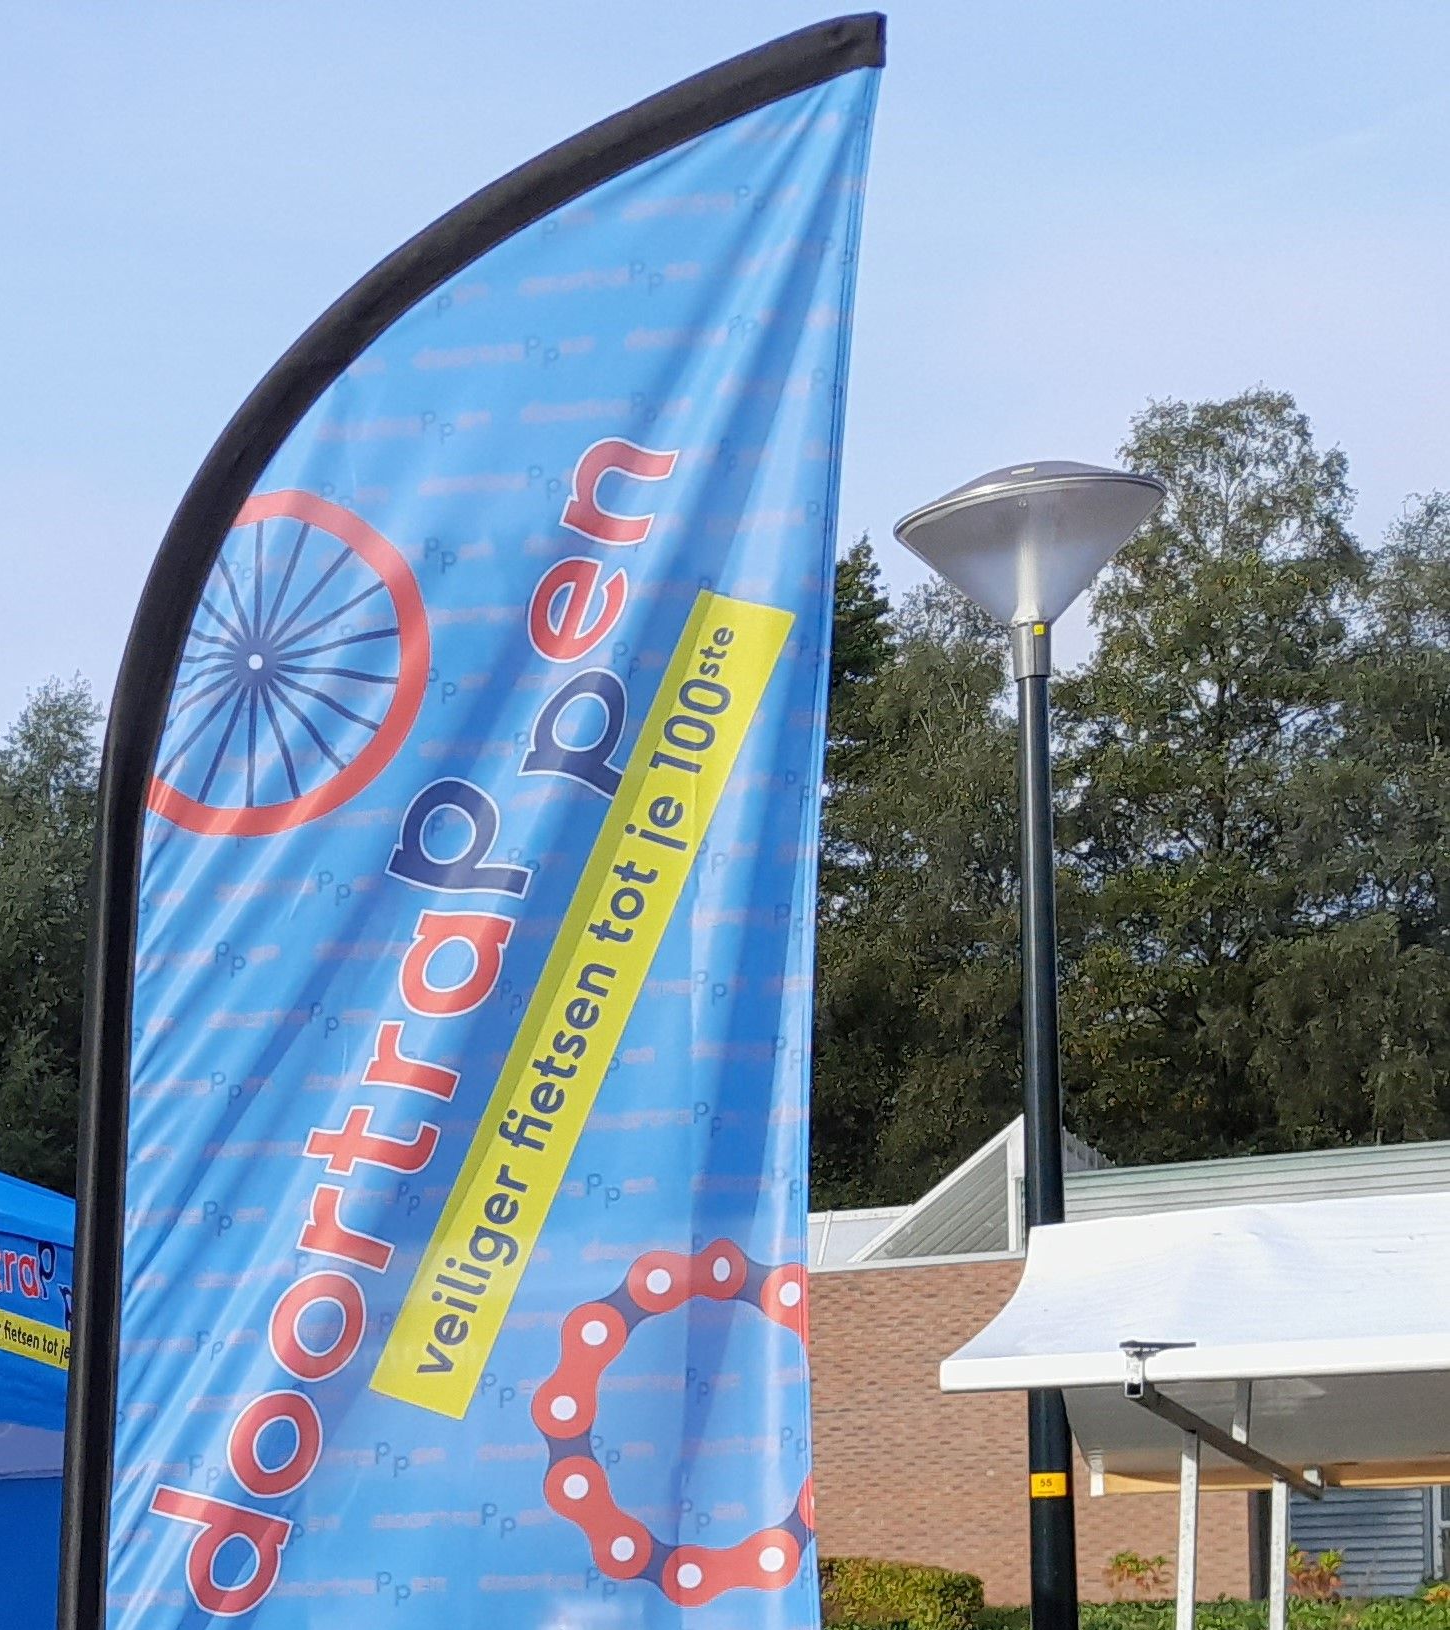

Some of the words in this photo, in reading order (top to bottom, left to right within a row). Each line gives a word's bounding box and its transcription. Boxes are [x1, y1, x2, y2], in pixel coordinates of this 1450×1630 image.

[649, 627, 734, 774] 100ste
[625, 795, 687, 851] je
[587, 861, 657, 944] tot
[150, 436, 679, 1617] doortrappen
[499, 964, 617, 1152] fietsen
[4, 1320, 40, 1350] fietsen
[42, 1334, 58, 1358] tot
[417, 1164, 528, 1374] veiliger
